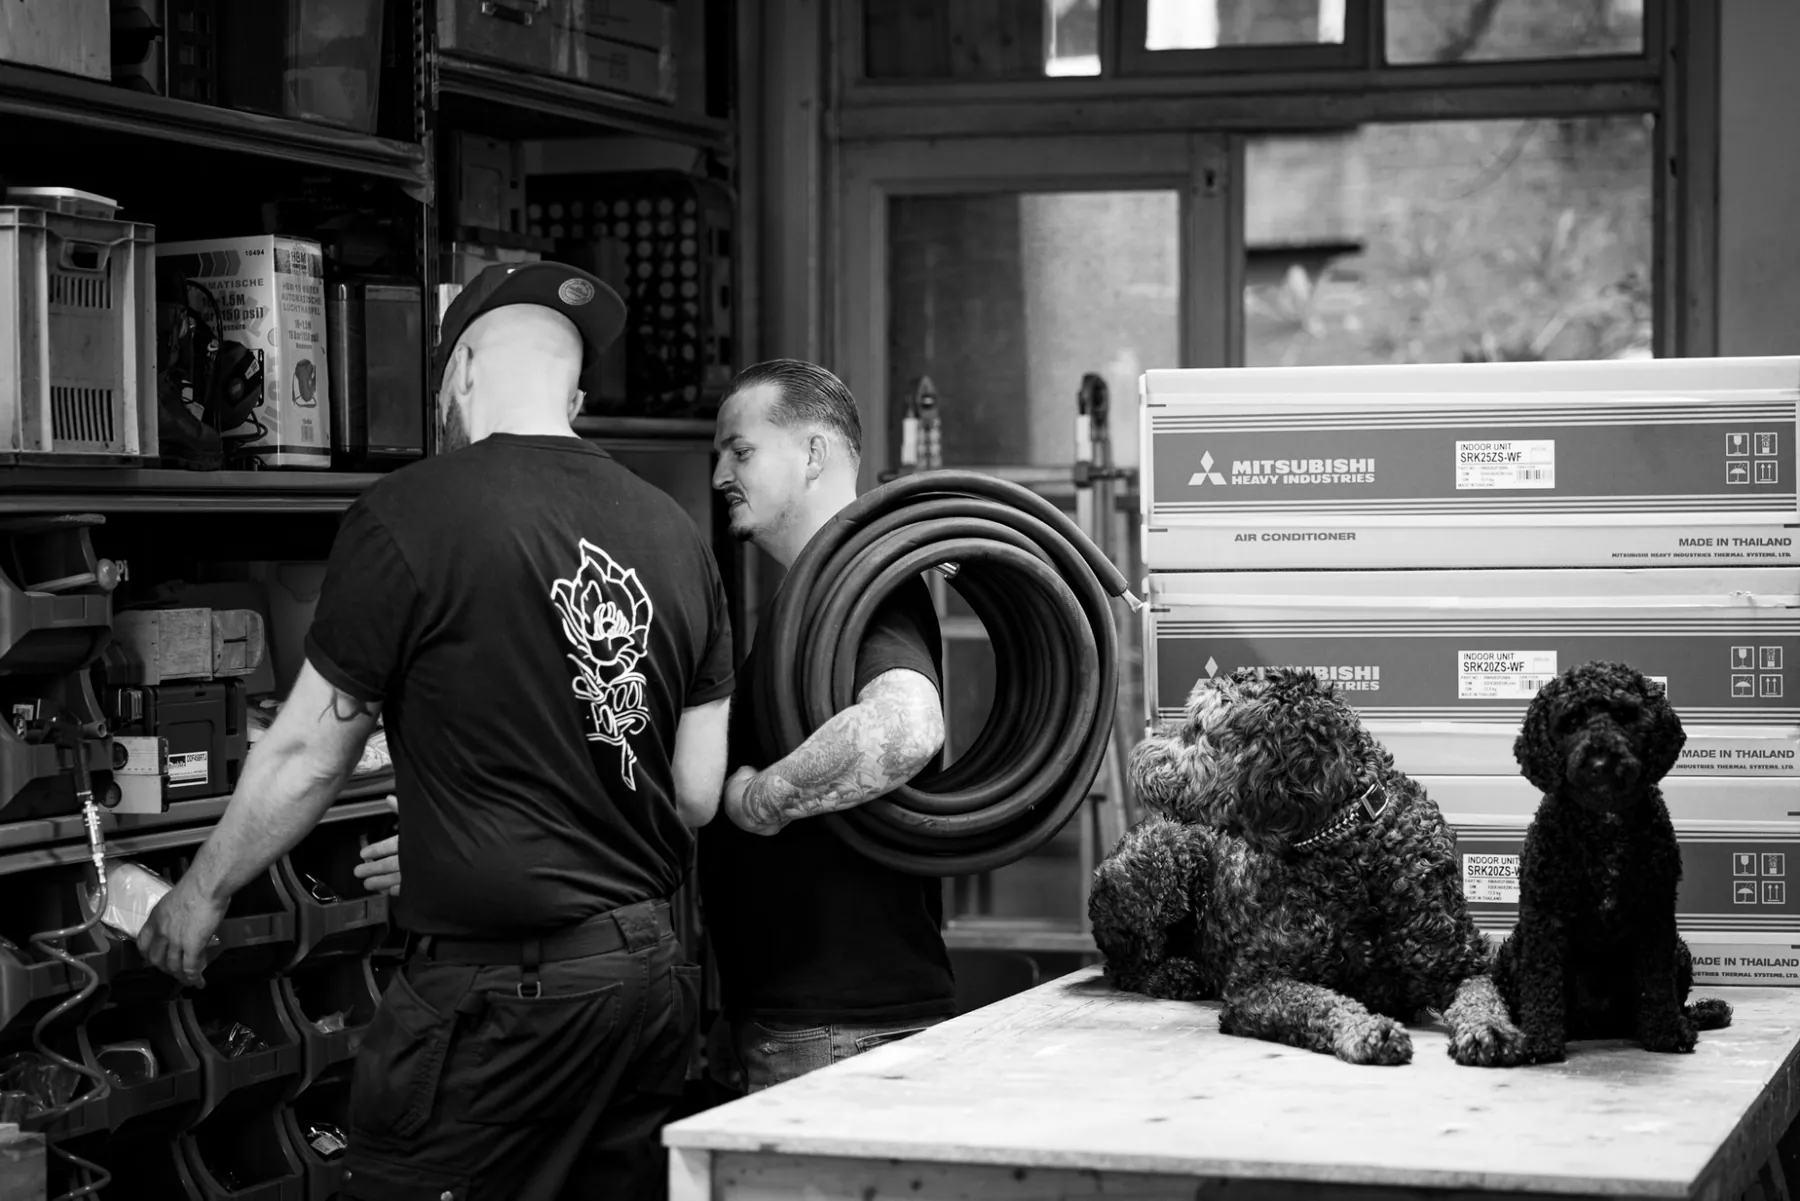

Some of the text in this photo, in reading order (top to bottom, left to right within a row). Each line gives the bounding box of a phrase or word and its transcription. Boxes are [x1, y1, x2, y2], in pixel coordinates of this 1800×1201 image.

[204, 278, 264, 289] MATISCHE
[1460, 443, 1512, 451] INDOOR UNIT
[1460, 452, 1522, 463] SRK25ZS-WF
[1231, 458, 1375, 475] MITSUBISHI
[1231, 473, 1375, 485] HEAVY INDUSTRIES
[1234, 532, 1356, 542] AIR CONDITIONER
[1678, 537, 1792, 547] MADE IN THAILAND
[1463, 652, 1515, 661] INDOOR UNIT
[1463, 661, 1525, 672] SRK20ZS-WF
[1681, 749, 1795, 759] MADE IN THAILAND
[1467, 856, 1519, 865] INDOOR UNIT
[1724, 957, 1736, 966] IN
[1739, 957, 1799, 967] THAILAND
